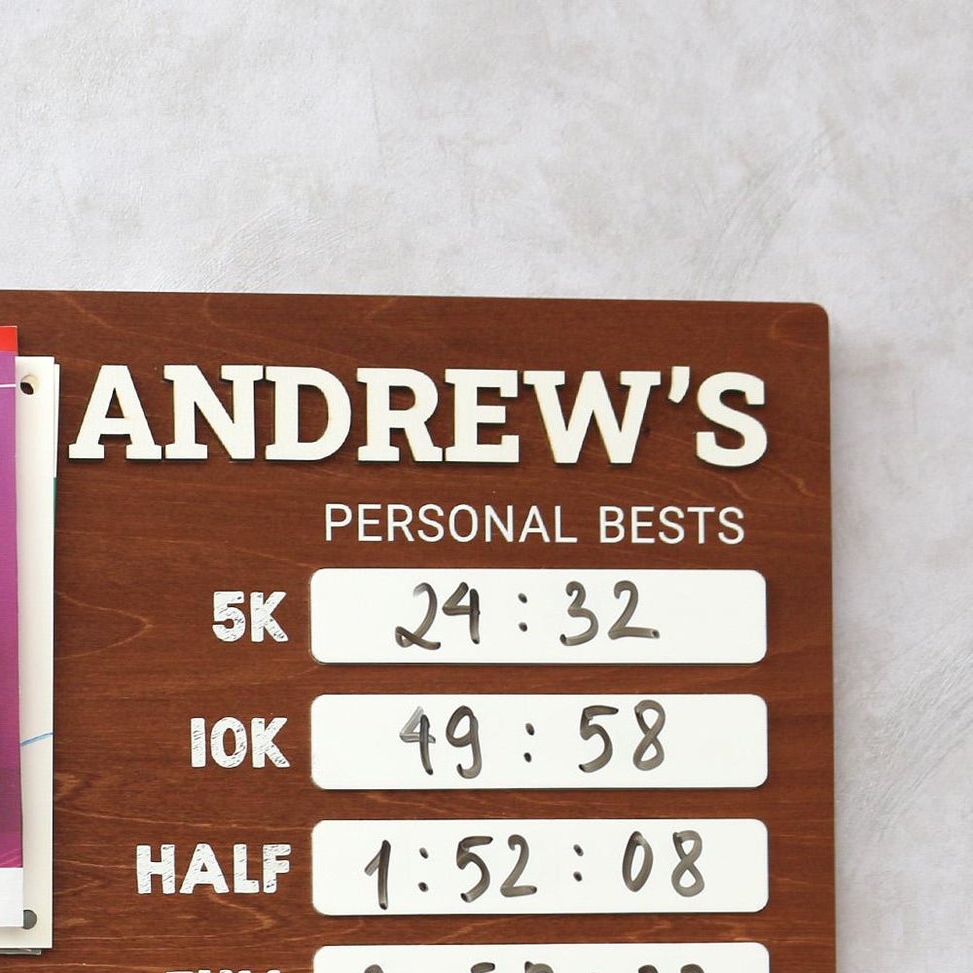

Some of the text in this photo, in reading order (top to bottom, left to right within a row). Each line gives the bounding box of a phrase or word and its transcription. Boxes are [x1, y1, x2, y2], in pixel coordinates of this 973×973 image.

[68, 364, 768, 467] ANDREW'S
[324, 503, 745, 545] PERSONAL BESTS
[211, 590, 289, 643] 5K
[135, 843, 292, 894] HALF
